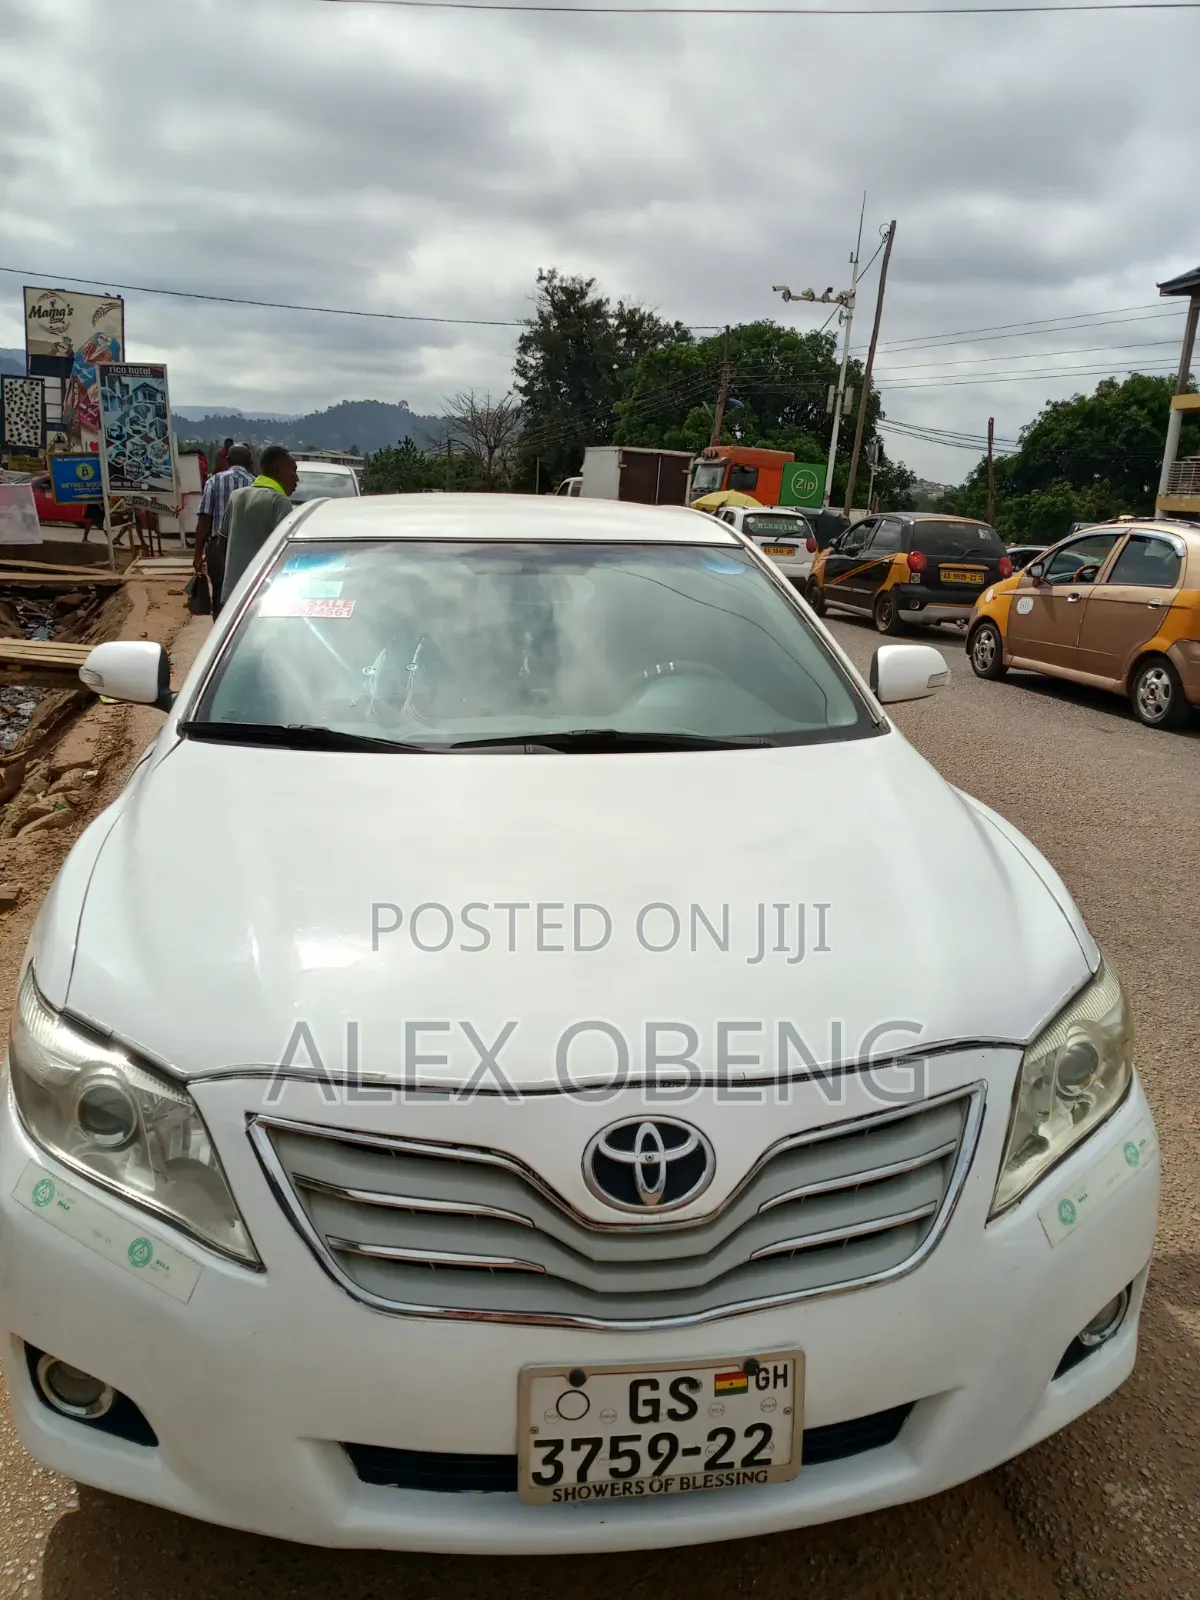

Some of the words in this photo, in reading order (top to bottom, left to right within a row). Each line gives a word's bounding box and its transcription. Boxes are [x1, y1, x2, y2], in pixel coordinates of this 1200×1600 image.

[28, 303, 74, 319] Mama's
[108, 365, 127, 374] rico
[128, 366, 151, 376] hotel
[795, 478, 815, 491] Zip
[758, 523, 798, 531] BLESSING
[629, 1376, 699, 1424] GS
[754, 1363, 788, 1391] GH
[531, 1423, 773, 1487] 3759-22
[552, 1480, 645, 1503] SHOWERS
[649, 1477, 673, 1493] OF
[679, 1470, 769, 1491] BLESSING
